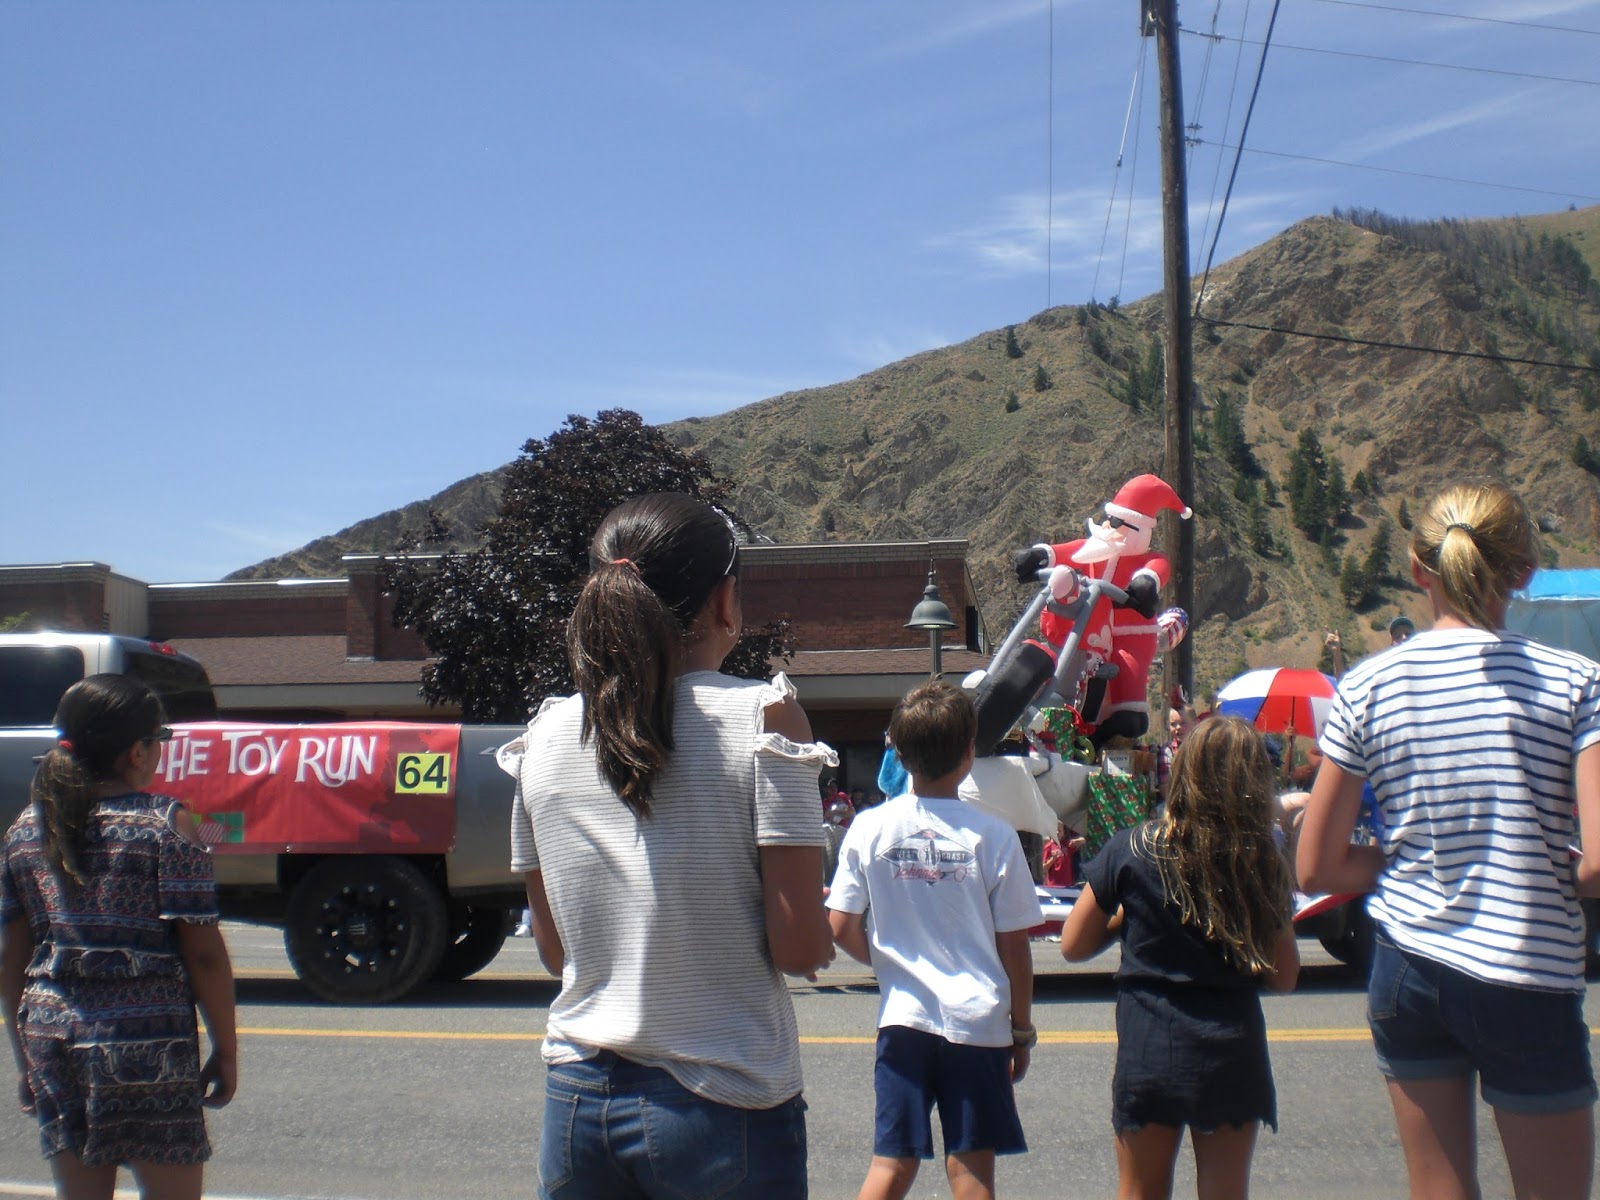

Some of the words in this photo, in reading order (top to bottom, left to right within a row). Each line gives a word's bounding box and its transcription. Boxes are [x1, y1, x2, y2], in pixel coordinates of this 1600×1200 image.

[222, 731, 288, 776] TOY
[295, 736, 377, 788] RUN
[397, 756, 447, 789] 64
[895, 849, 917, 859] WEST
[942, 852, 965, 862] COAST
